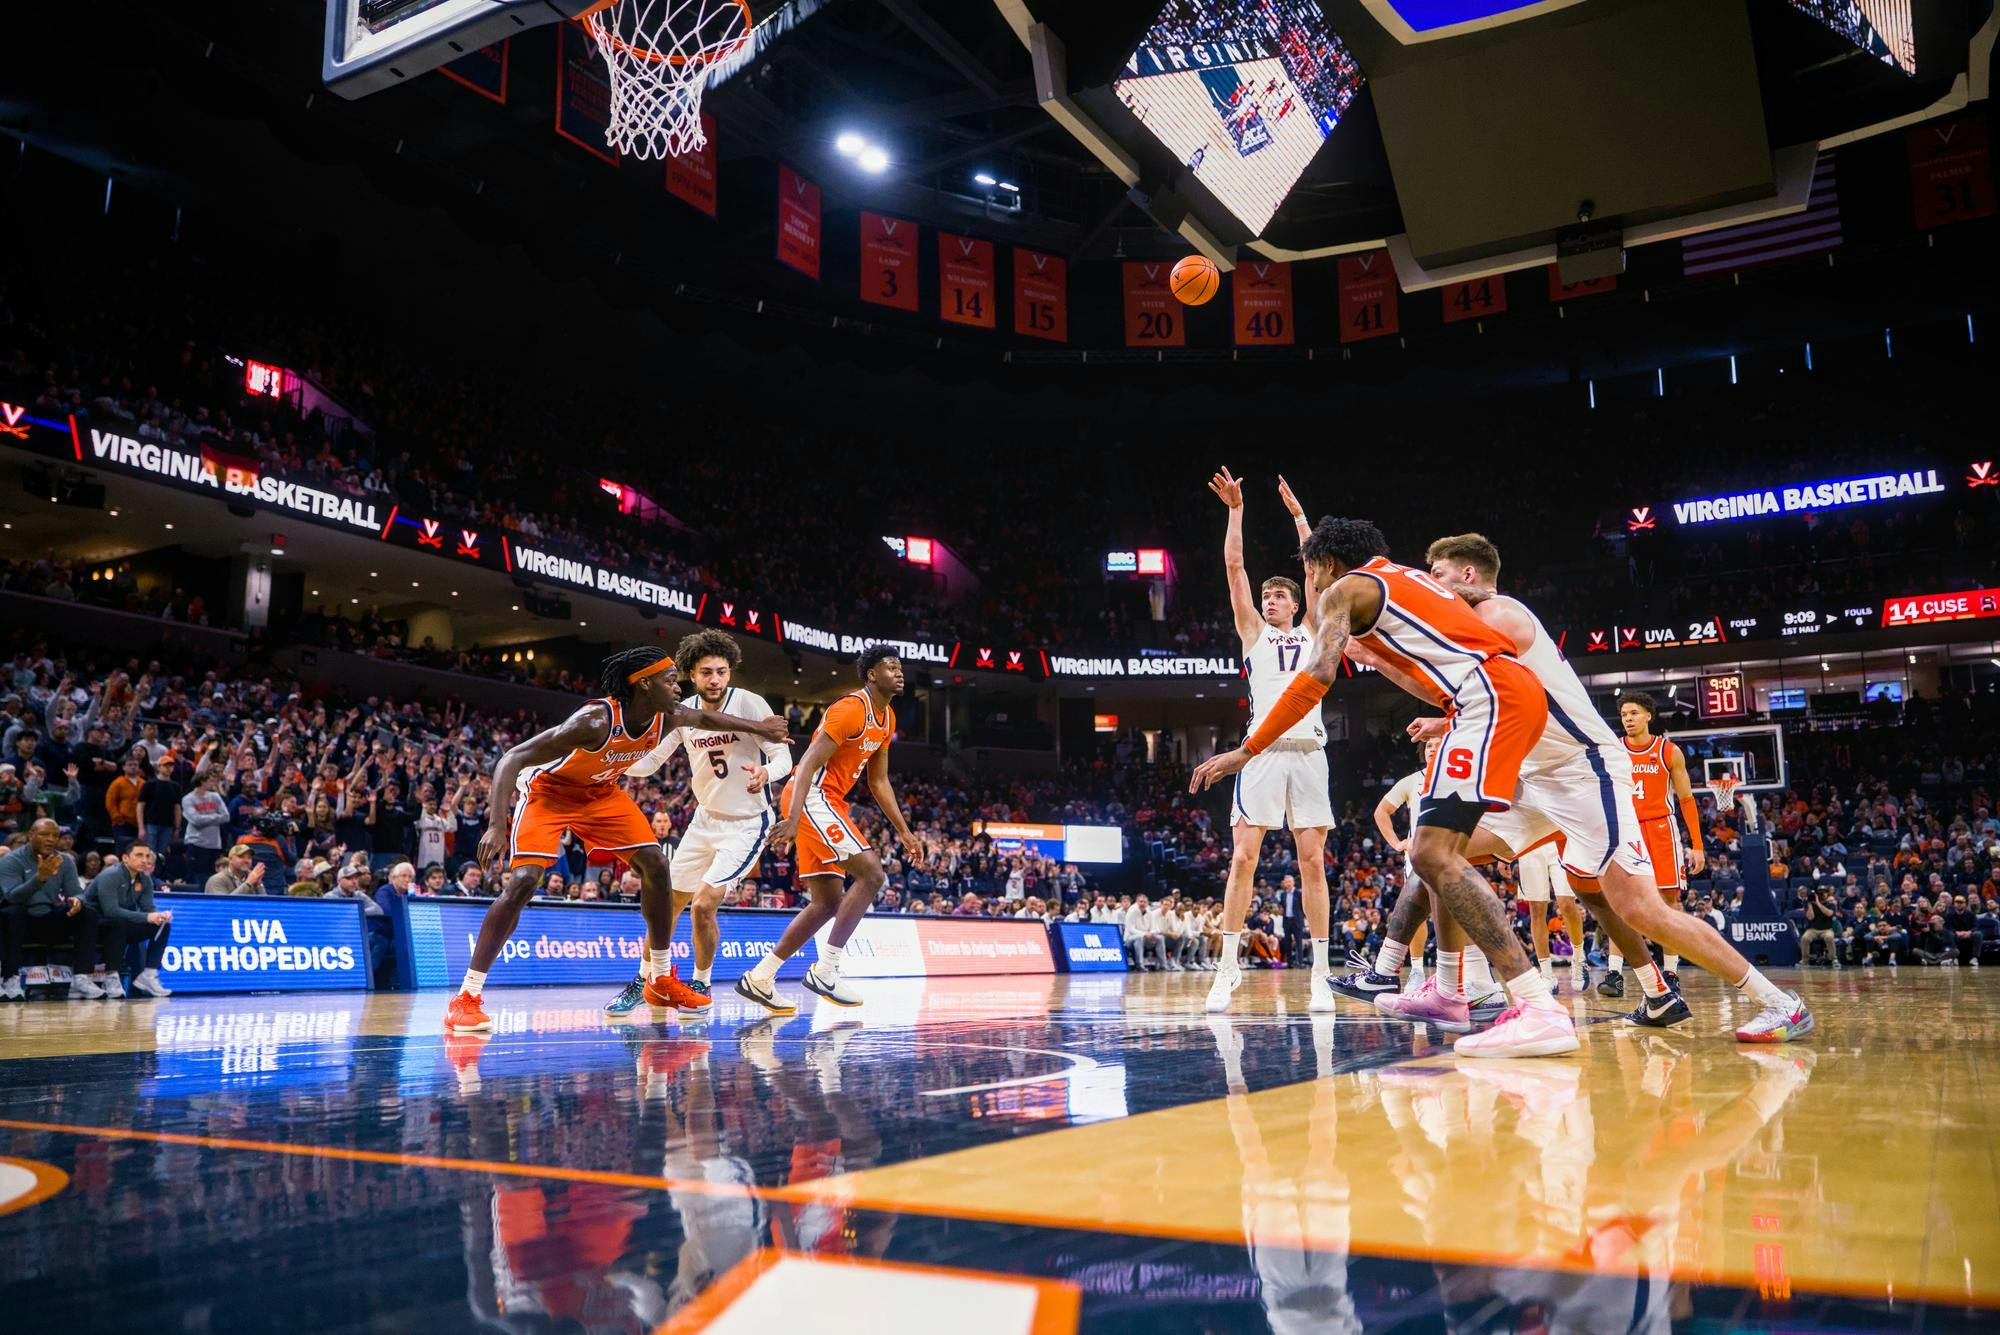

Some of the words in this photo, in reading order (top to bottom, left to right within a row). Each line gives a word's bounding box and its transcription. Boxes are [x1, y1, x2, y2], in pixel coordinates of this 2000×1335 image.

[1126, 42, 1269, 75] VIRGINIA
[881, 270, 897, 298] 3
[1453, 278, 1493, 312] 44
[954, 288, 982, 319] 14
[1029, 302, 1055, 332] 15
[1137, 312, 1173, 339] 20
[1245, 311, 1282, 338] 40
[1353, 303, 1385, 332] 41
[91, 428, 219, 488] VIRGINIA
[225, 467, 381, 531] BASKETBALL
[1673, 491, 1780, 525] VIRGINIA
[1783, 470, 1945, 511] BASKETBALL
[515, 545, 594, 588] VIRGINIA
[597, 569, 697, 615] BASKETBALL
[1784, 611, 1817, 625] 9:09
[1844, 607, 1873, 617] FOULS
[1889, 602, 1920, 621] 14
[1922, 598, 1968, 615] CUSE
[1645, 629, 1675, 643] UVA
[1689, 621, 1717, 639] 24
[1730, 618, 1757, 628] FOULS
[1781, 627, 1798, 636] 1ST
[1799, 624, 1821, 634] HALF
[782, 620, 838, 651] VIRGINIA
[841, 635, 949, 663] BASTBALL
[1051, 656, 1125, 675] VIRGINIA
[1128, 658, 1240, 675] BASKETBALL
[1277, 644, 1301, 671] 17
[1710, 677, 1739, 690] 9:09
[1708, 690, 1737, 713] 30
[691, 733, 740, 749] VIRGINIA
[708, 750, 728, 779] 5
[1446, 748, 1474, 780] S
[826, 824, 844, 844] S
[231, 919, 287, 943] UVA
[1745, 923, 1788, 932] UNITED
[1746, 932, 1776, 941] BANK
[535, 935, 616, 958] doesn't
[721, 941, 742, 957] an
[928, 940, 960, 955] Driven
[960, 940, 971, 955] to
[971, 941, 996, 957] bring
[995, 941, 1017, 957] hope
[1084, 934, 1102, 947] UVA
[161, 946, 355, 971] ORTHOPEDICS
[1069, 948, 1122, 962] ORTHOPEDICS
